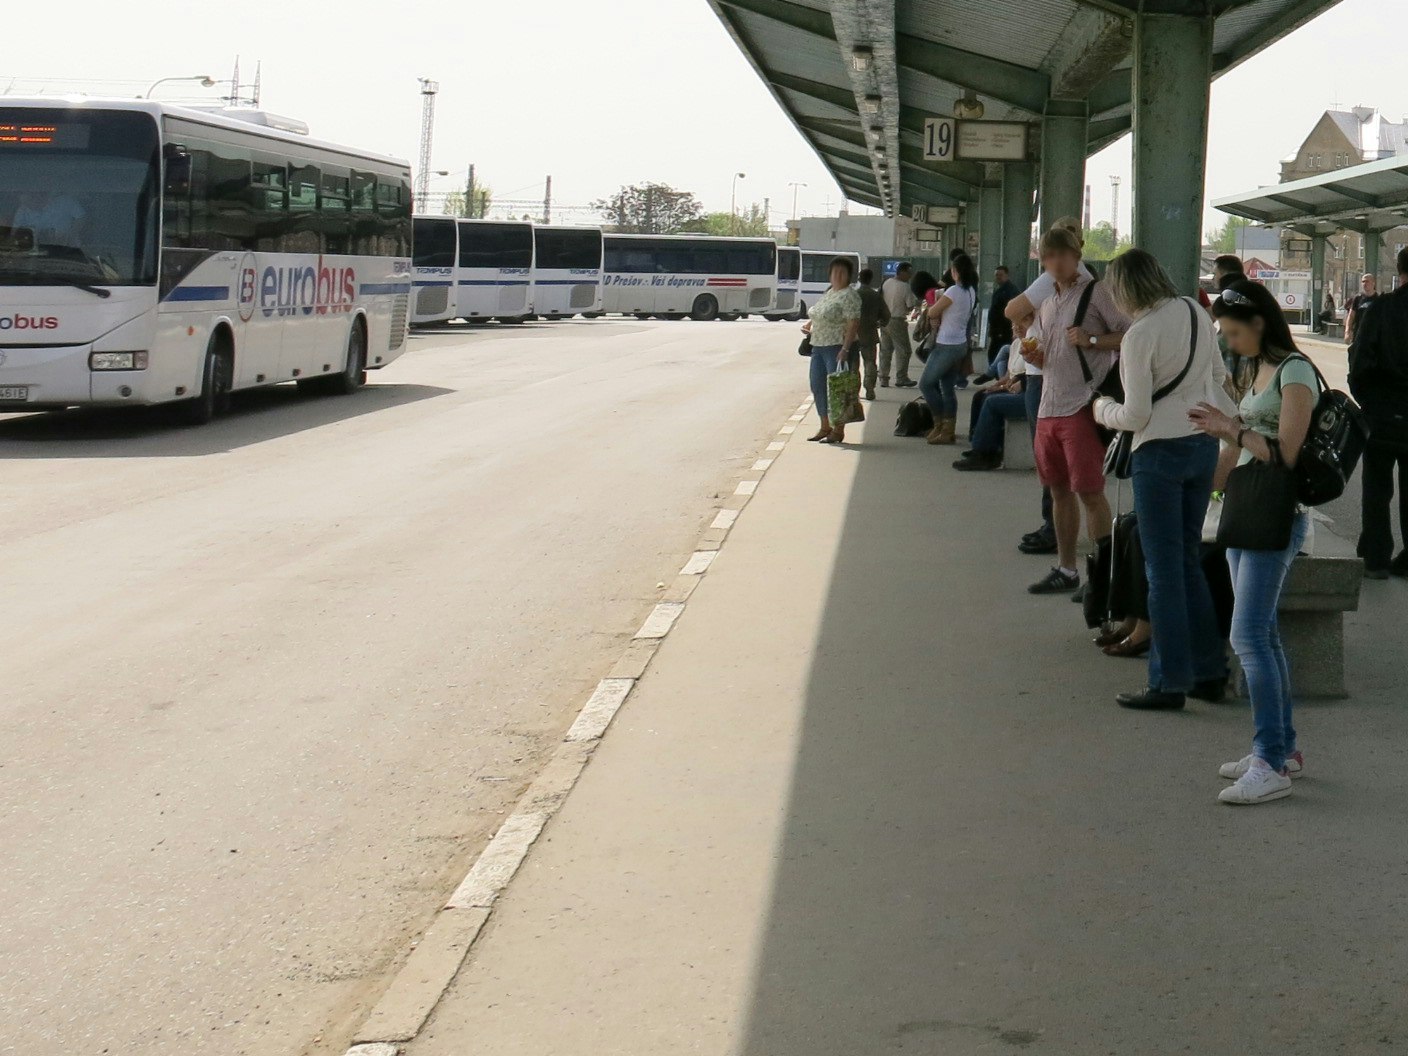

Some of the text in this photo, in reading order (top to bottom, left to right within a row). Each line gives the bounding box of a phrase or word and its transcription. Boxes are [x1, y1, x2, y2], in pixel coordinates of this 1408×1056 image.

[925, 122, 952, 157] 19
[913, 206, 926, 223] 20
[260, 254, 356, 317] eurobus
[613, 275, 643, 286] Prešov
[668, 276, 706, 288] dopravca
